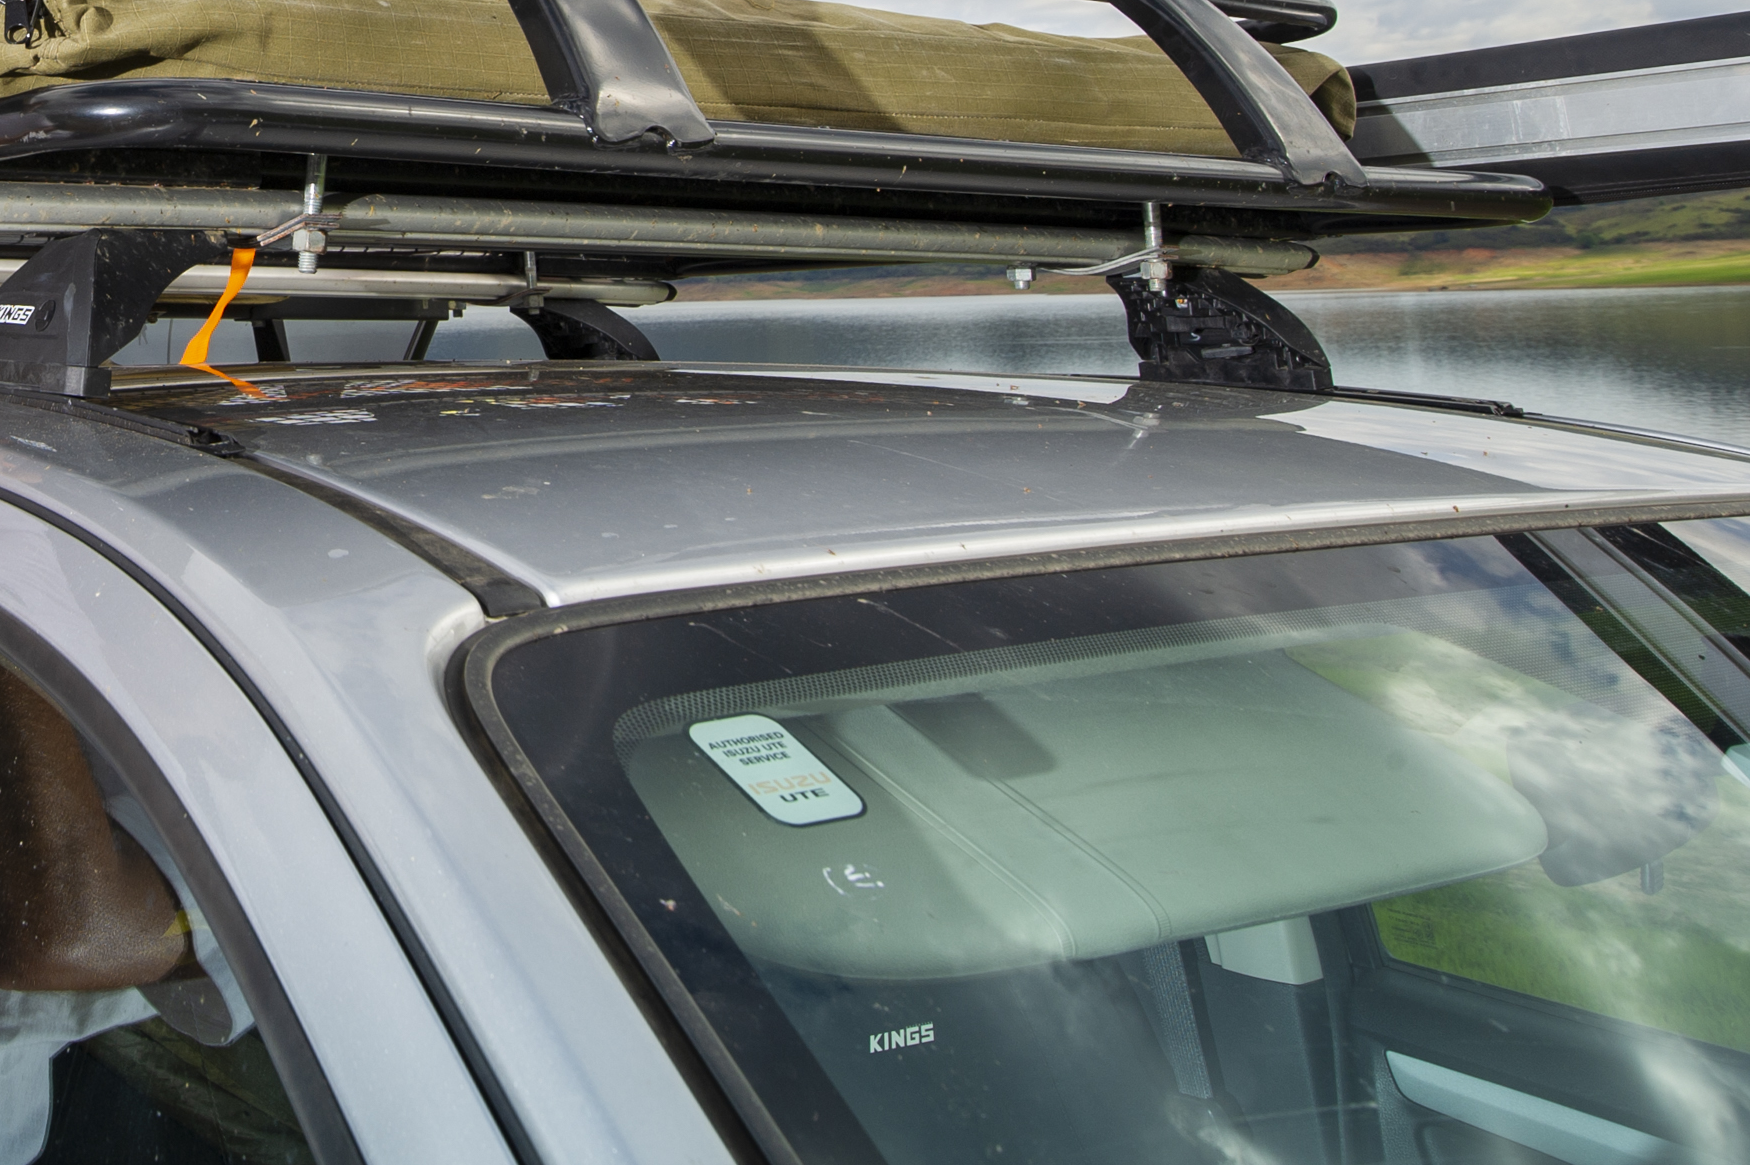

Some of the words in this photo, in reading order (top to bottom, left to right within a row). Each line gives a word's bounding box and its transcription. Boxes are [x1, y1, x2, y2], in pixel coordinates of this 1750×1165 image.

[708, 732, 784, 750] AUTHORISED
[722, 746, 761, 758] ISUZU
[763, 741, 786, 751] UTE
[739, 751, 790, 765] SERVICE
[748, 772, 832, 795] ISUZU
[780, 788, 829, 802] UTE
[870, 1023, 934, 1053] KINGS
